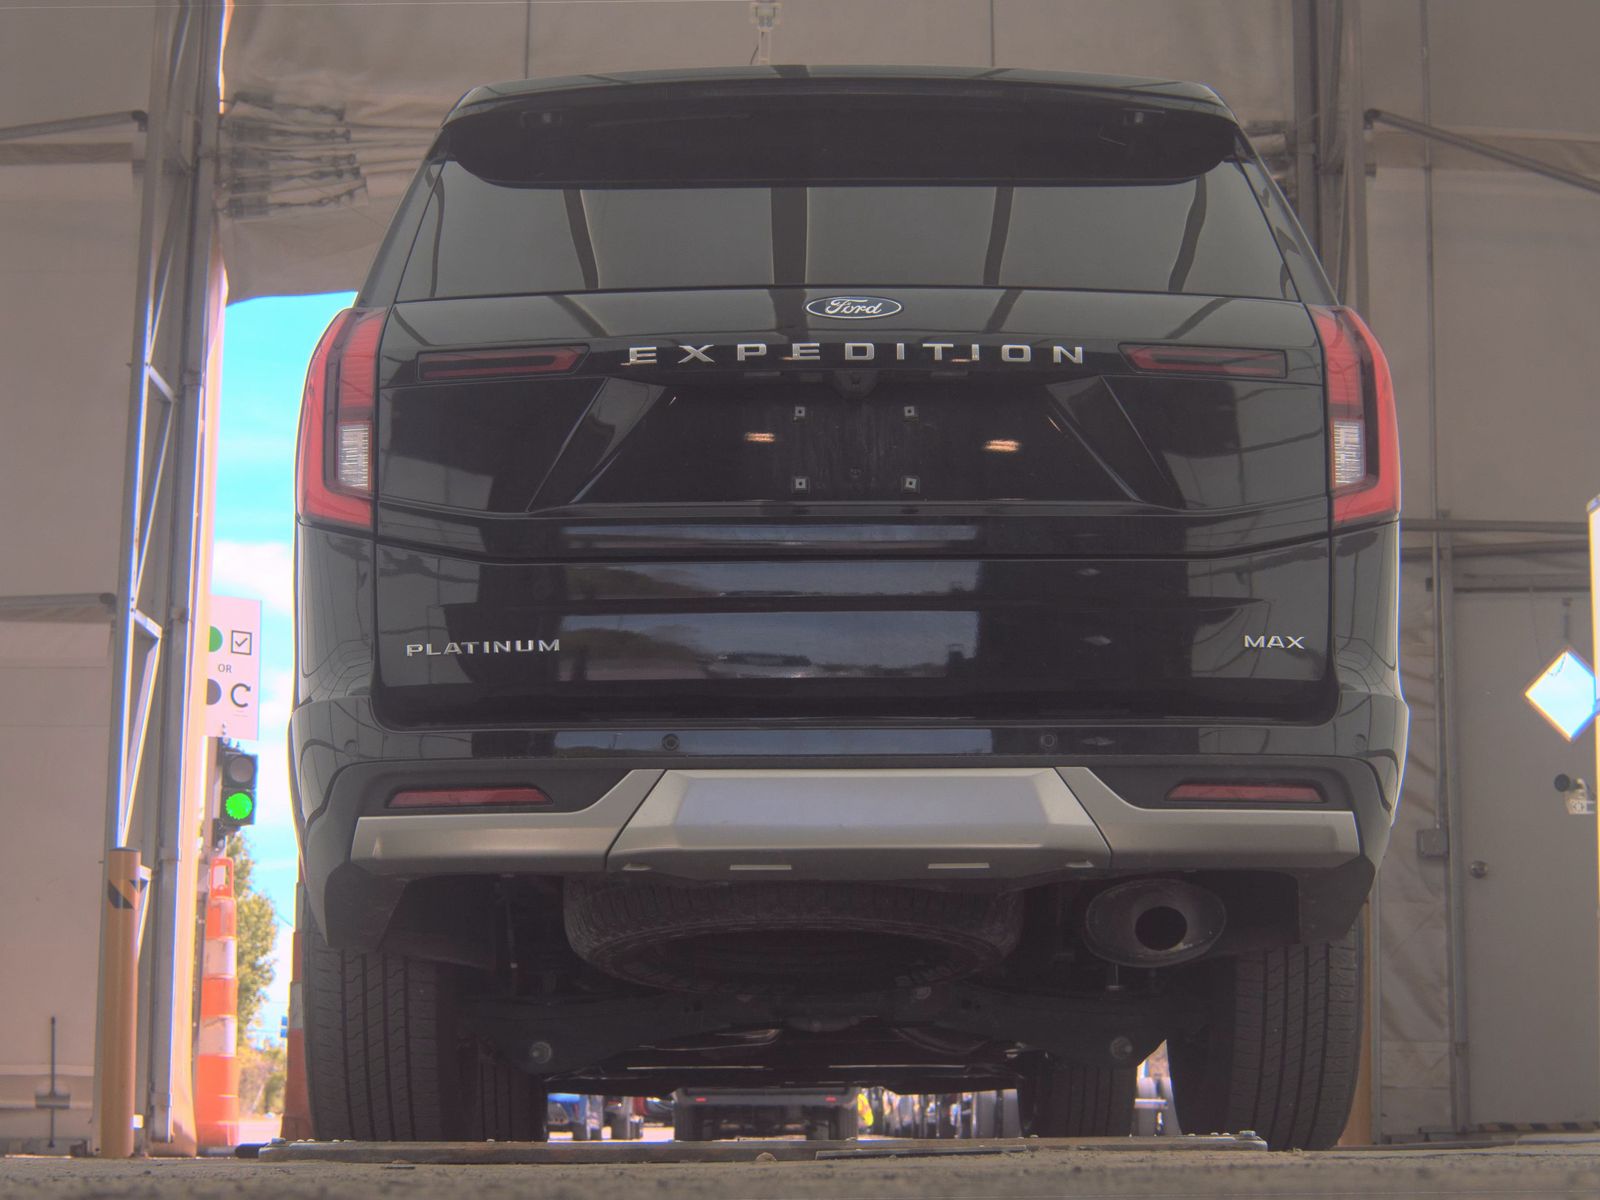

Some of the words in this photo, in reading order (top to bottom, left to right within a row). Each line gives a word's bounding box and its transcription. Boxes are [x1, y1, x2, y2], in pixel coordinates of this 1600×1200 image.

[825, 299, 882, 314] Ford
[629, 343, 1083, 364] EXPEDITION
[406, 639, 560, 656] PLATINUM
[1244, 635, 1305, 650] MAX
[218, 663, 232, 673] OR
